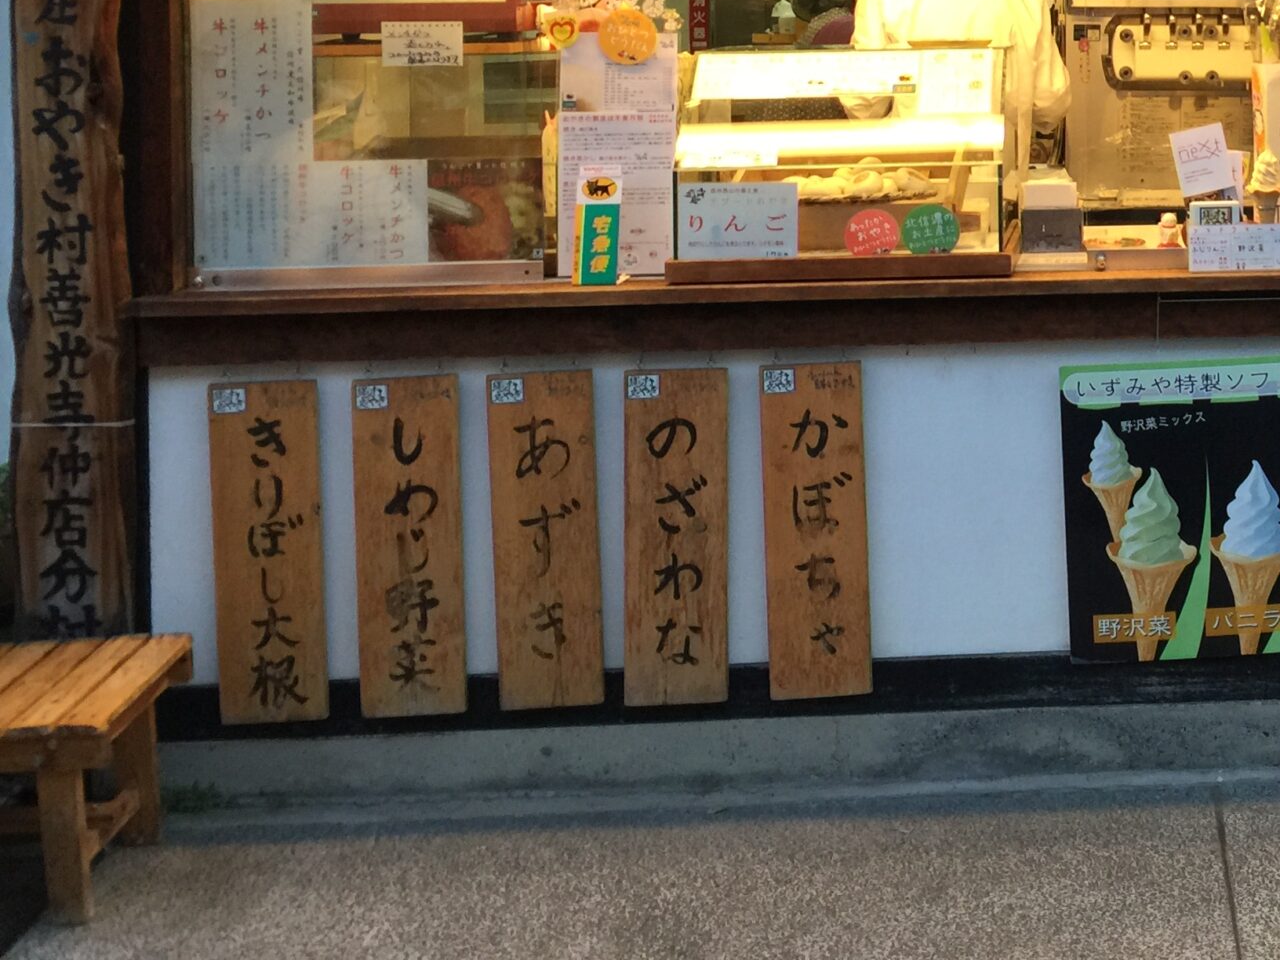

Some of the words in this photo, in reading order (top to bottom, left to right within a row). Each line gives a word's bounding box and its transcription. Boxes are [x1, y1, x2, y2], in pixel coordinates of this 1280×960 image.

[590, 214, 612, 273] 宅急便
[688, 214, 788, 233] りんご
[1120, 410, 1207, 434] 野沢菜ミックス
[246, 417, 310, 708] きりぼし大根
[513, 415, 582, 661] あずき
[646, 416, 708, 668] のざわな
[789, 408, 855, 657] かぼちゃ
[1097, 614, 1173, 639] 野沢菜
